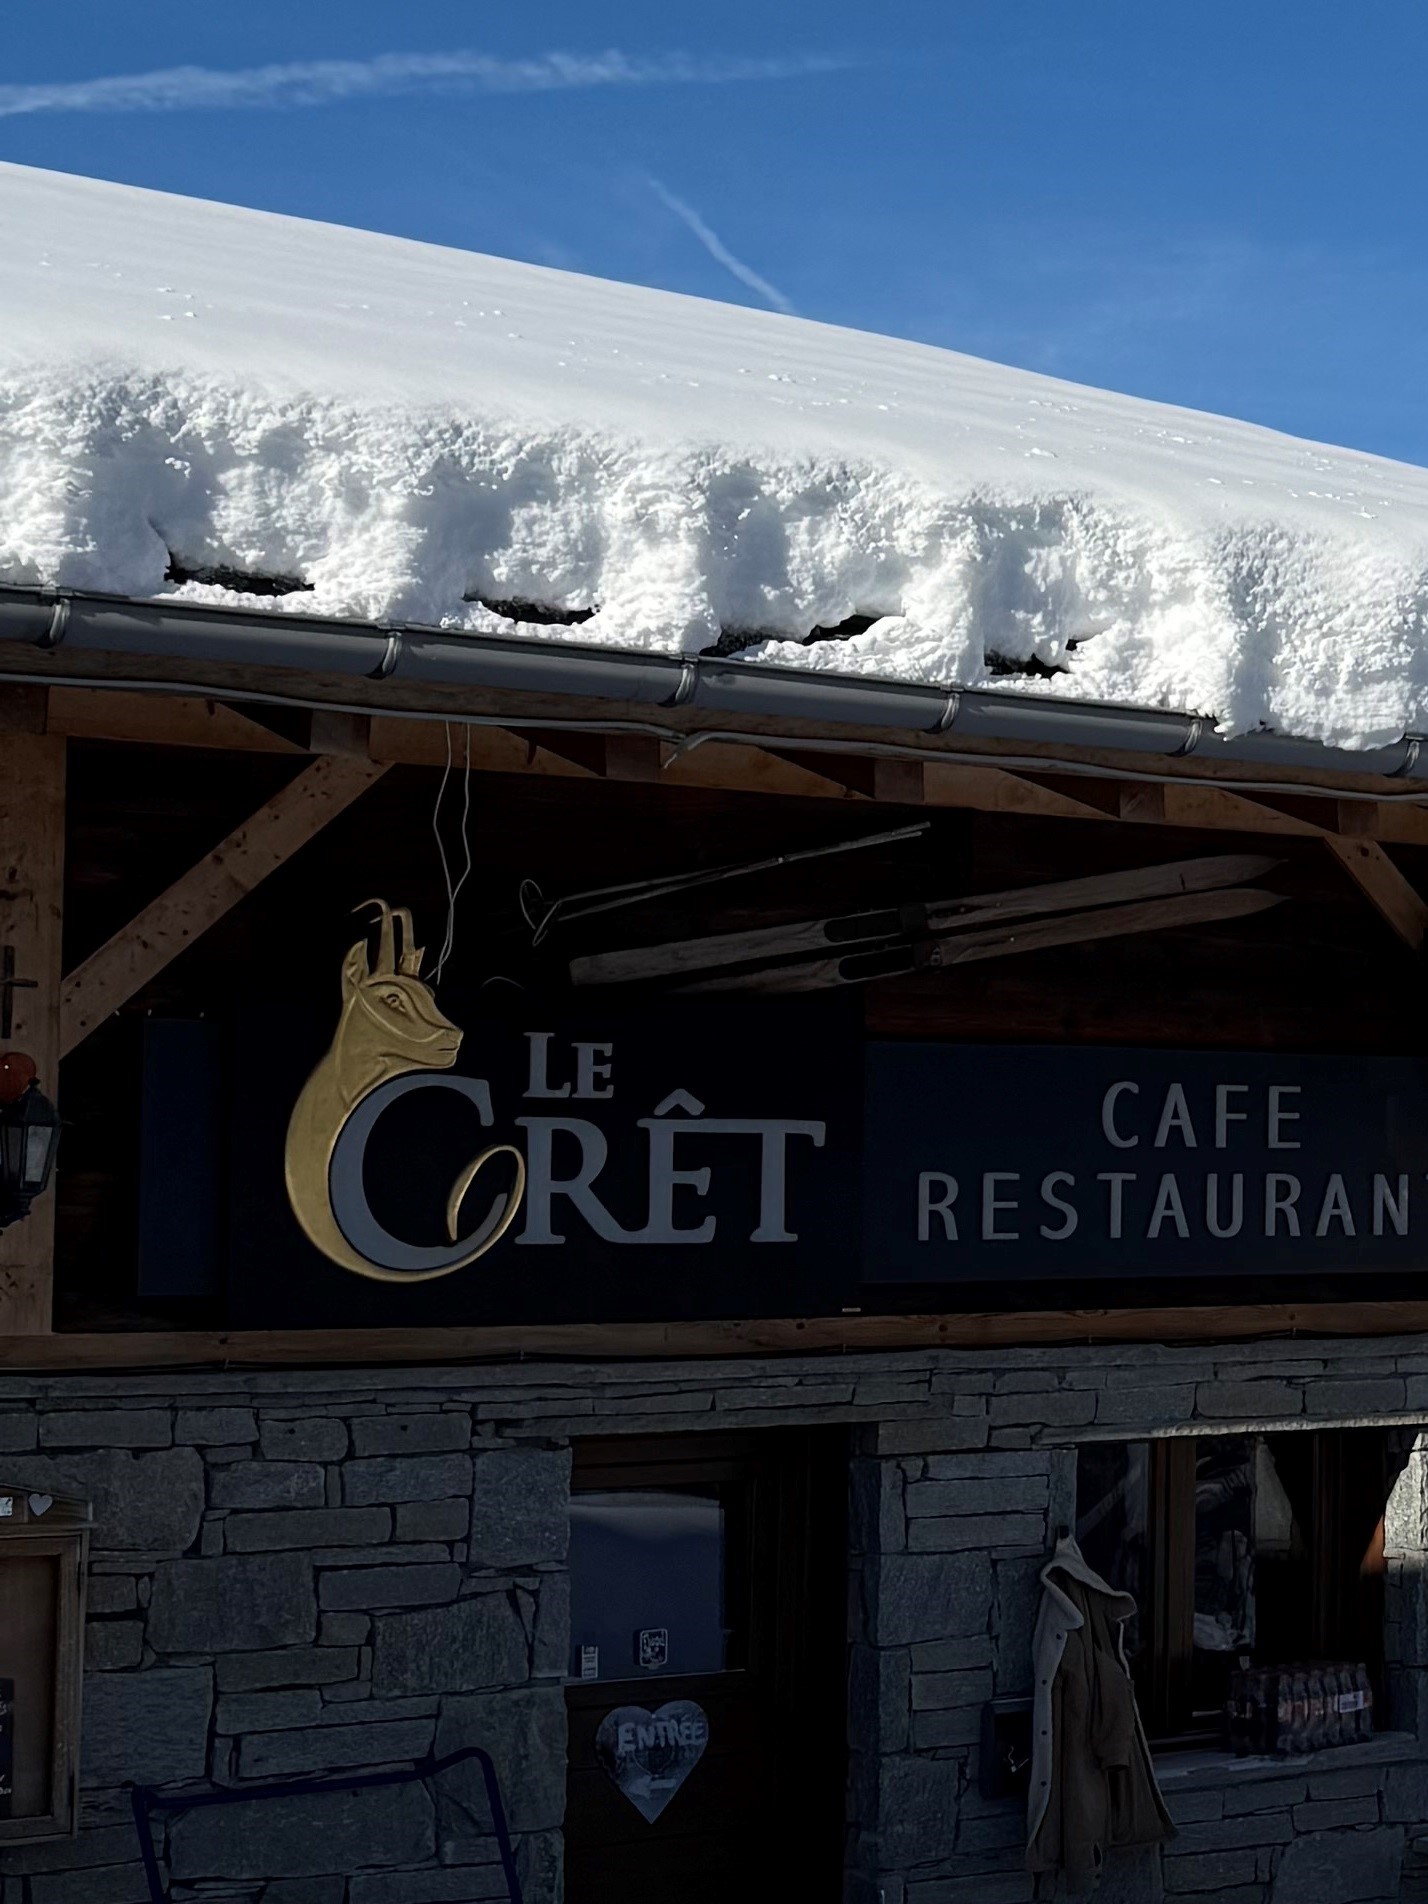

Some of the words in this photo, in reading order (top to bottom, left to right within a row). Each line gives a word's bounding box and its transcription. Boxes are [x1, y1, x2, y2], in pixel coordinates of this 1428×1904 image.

[521, 1032, 615, 1099] LE
[1102, 1081, 1302, 1149] CAFE
[330, 1074, 826, 1270] CRÊT
